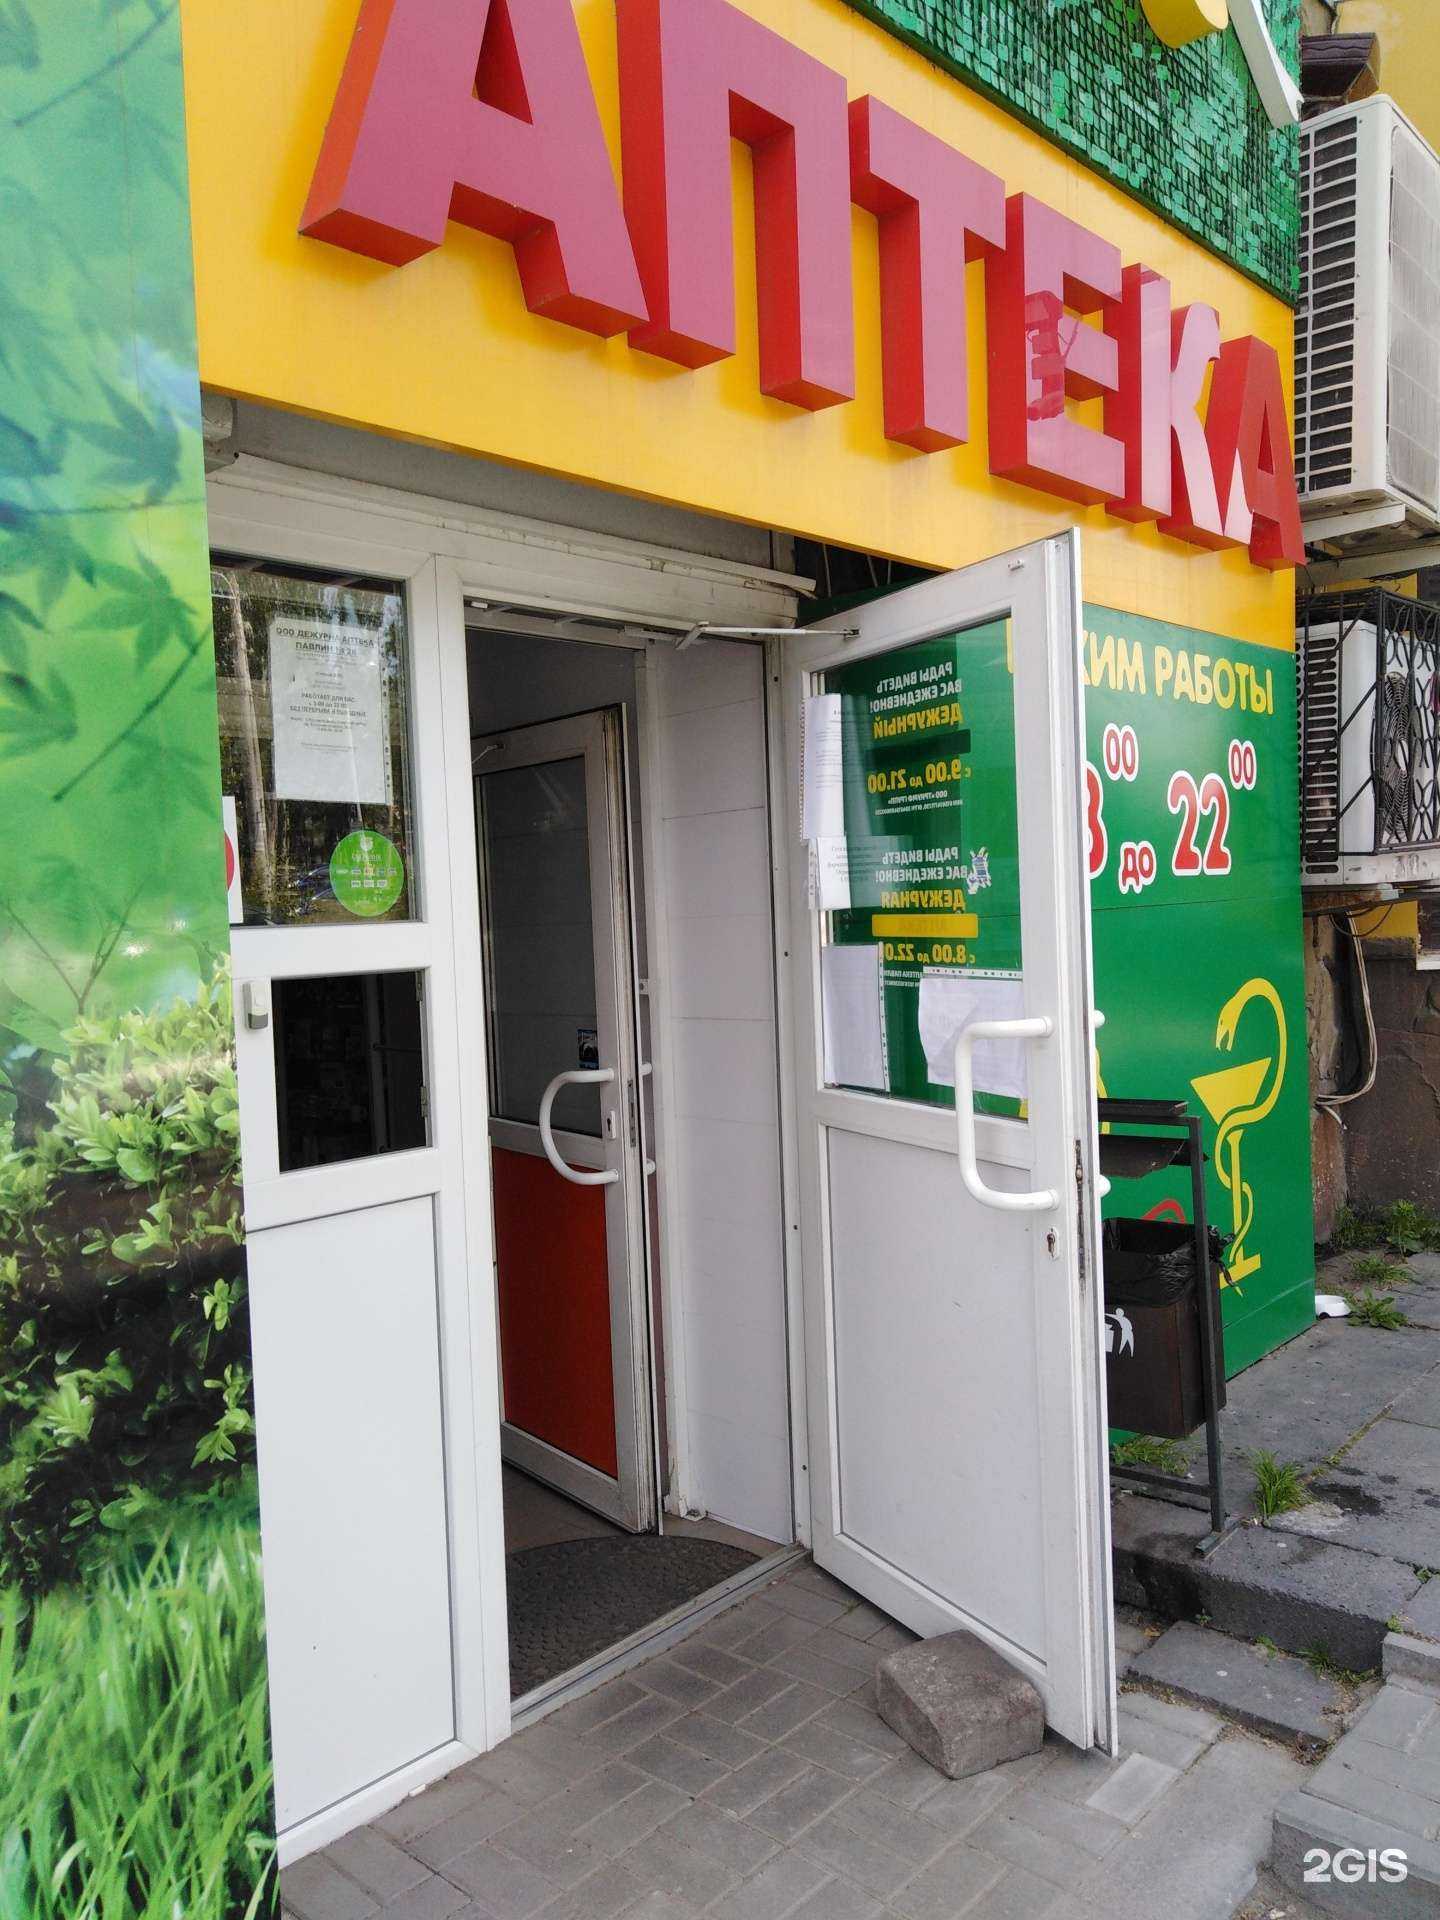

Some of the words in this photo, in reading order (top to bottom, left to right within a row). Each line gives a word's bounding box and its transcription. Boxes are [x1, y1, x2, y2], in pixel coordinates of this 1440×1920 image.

[300, 0, 1305, 570] АПТЕКА
[1154, 645, 1274, 715] РАБОТЫ
[1118, 840, 1157, 895] до
[1167, 770, 1231, 876] 22
